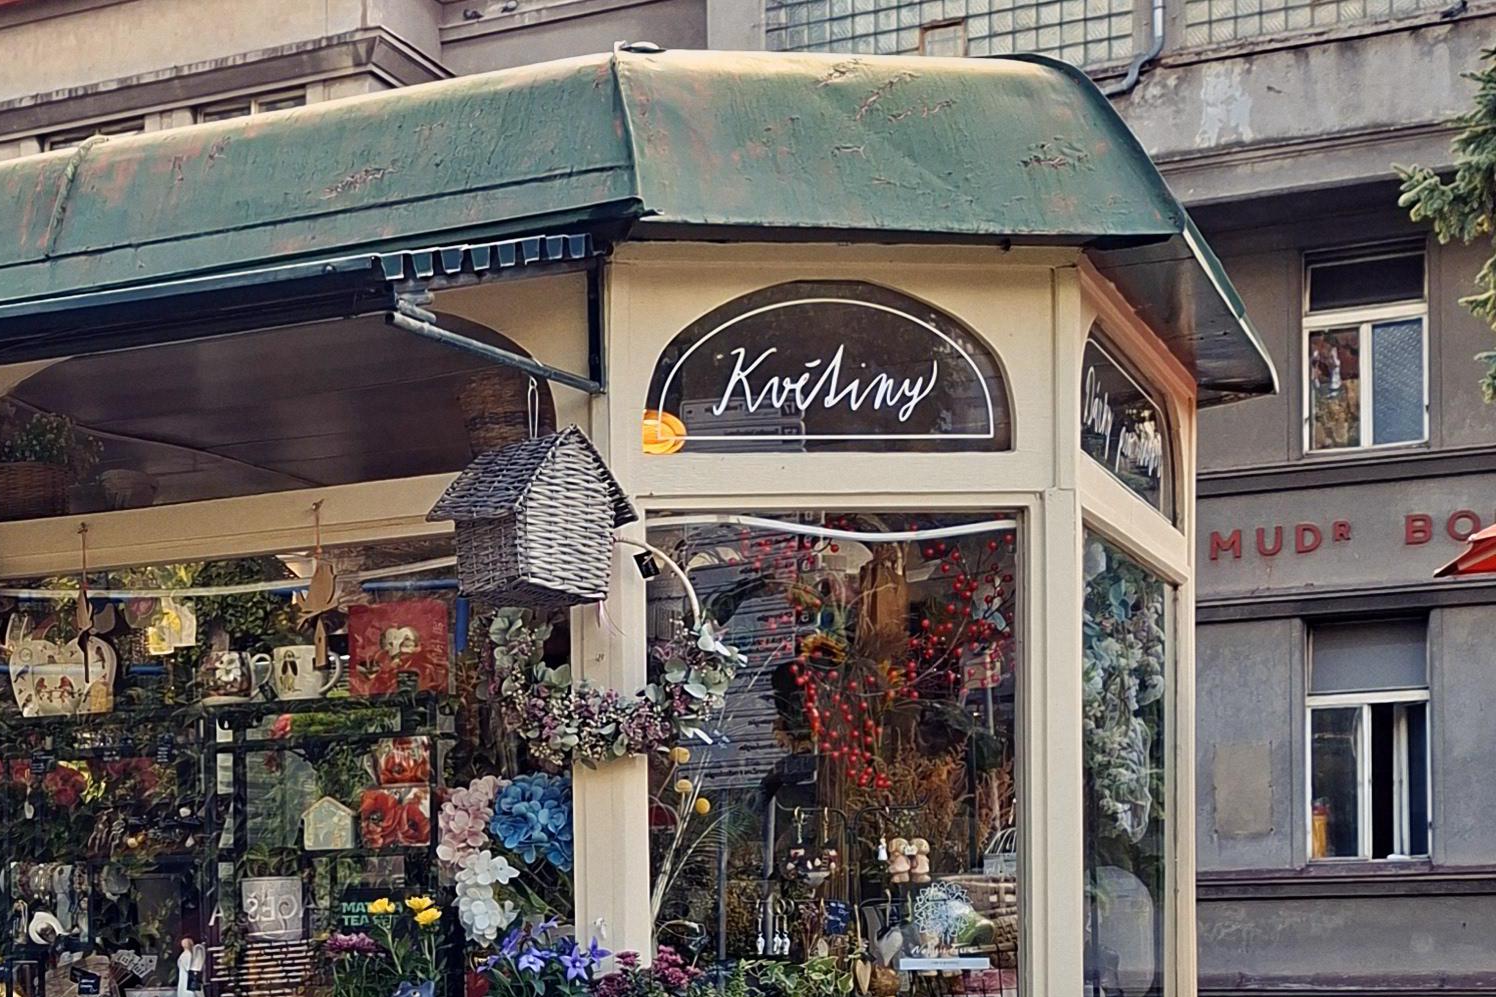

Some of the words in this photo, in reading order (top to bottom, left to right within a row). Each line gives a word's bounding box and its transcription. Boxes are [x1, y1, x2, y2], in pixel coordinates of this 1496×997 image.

[712, 343, 938, 423] Květiny
[1209, 520, 1352, 561] MUDR
[1404, 508, 1496, 546] BO
[341, 901, 404, 914] MATA
[341, 915, 370, 926] TEA
